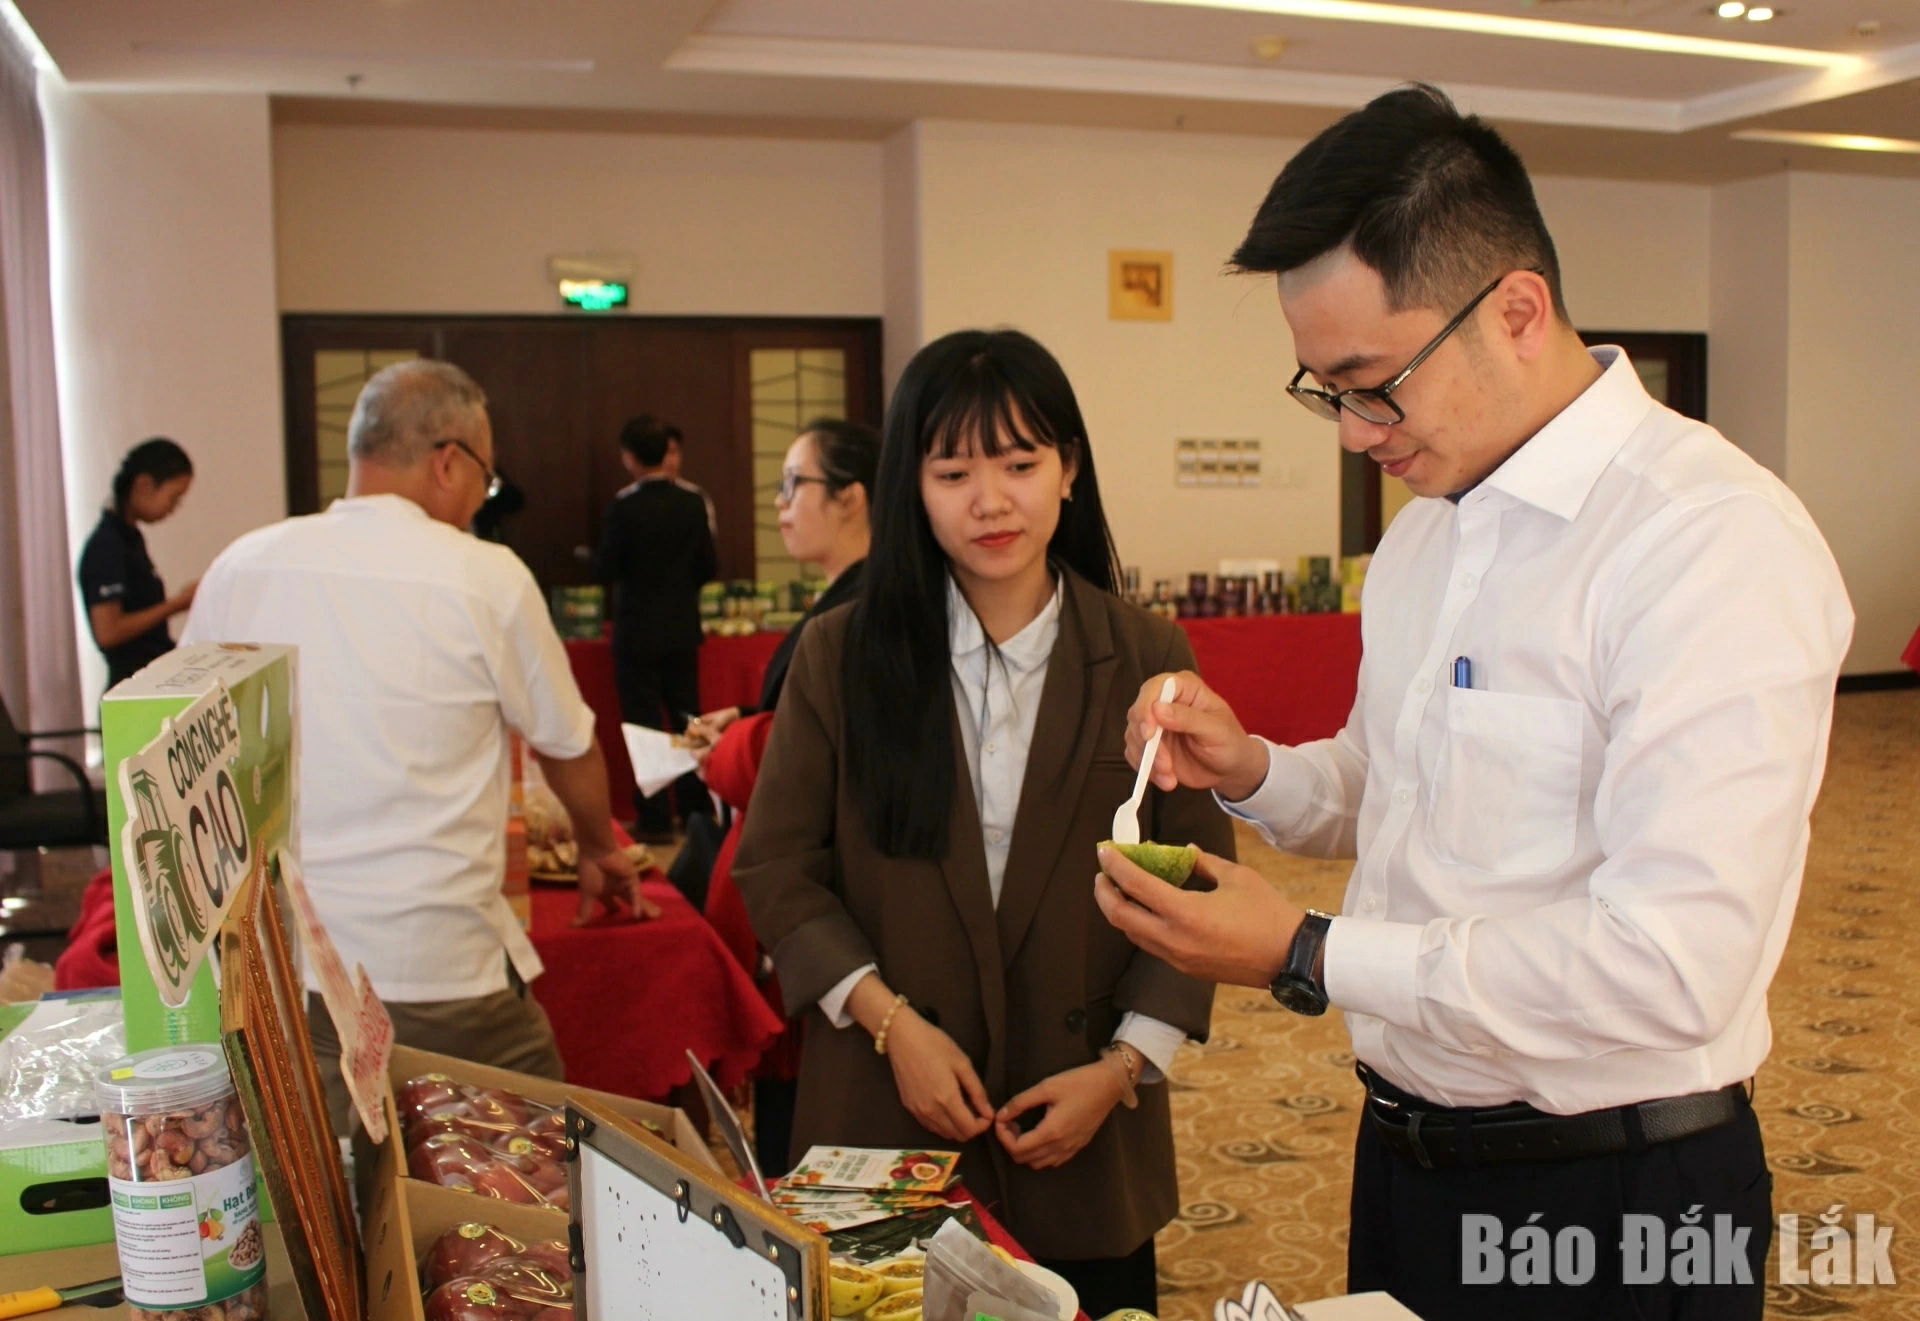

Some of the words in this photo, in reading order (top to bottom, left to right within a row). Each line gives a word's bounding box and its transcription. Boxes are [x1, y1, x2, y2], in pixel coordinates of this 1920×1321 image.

[167, 729, 206, 799] CÔNG
[197, 687, 238, 764] NGHỆ
[189, 769, 248, 909] CAO
[161, 1194, 190, 1204] KHÔNG
[223, 1194, 245, 1211] Hạt
